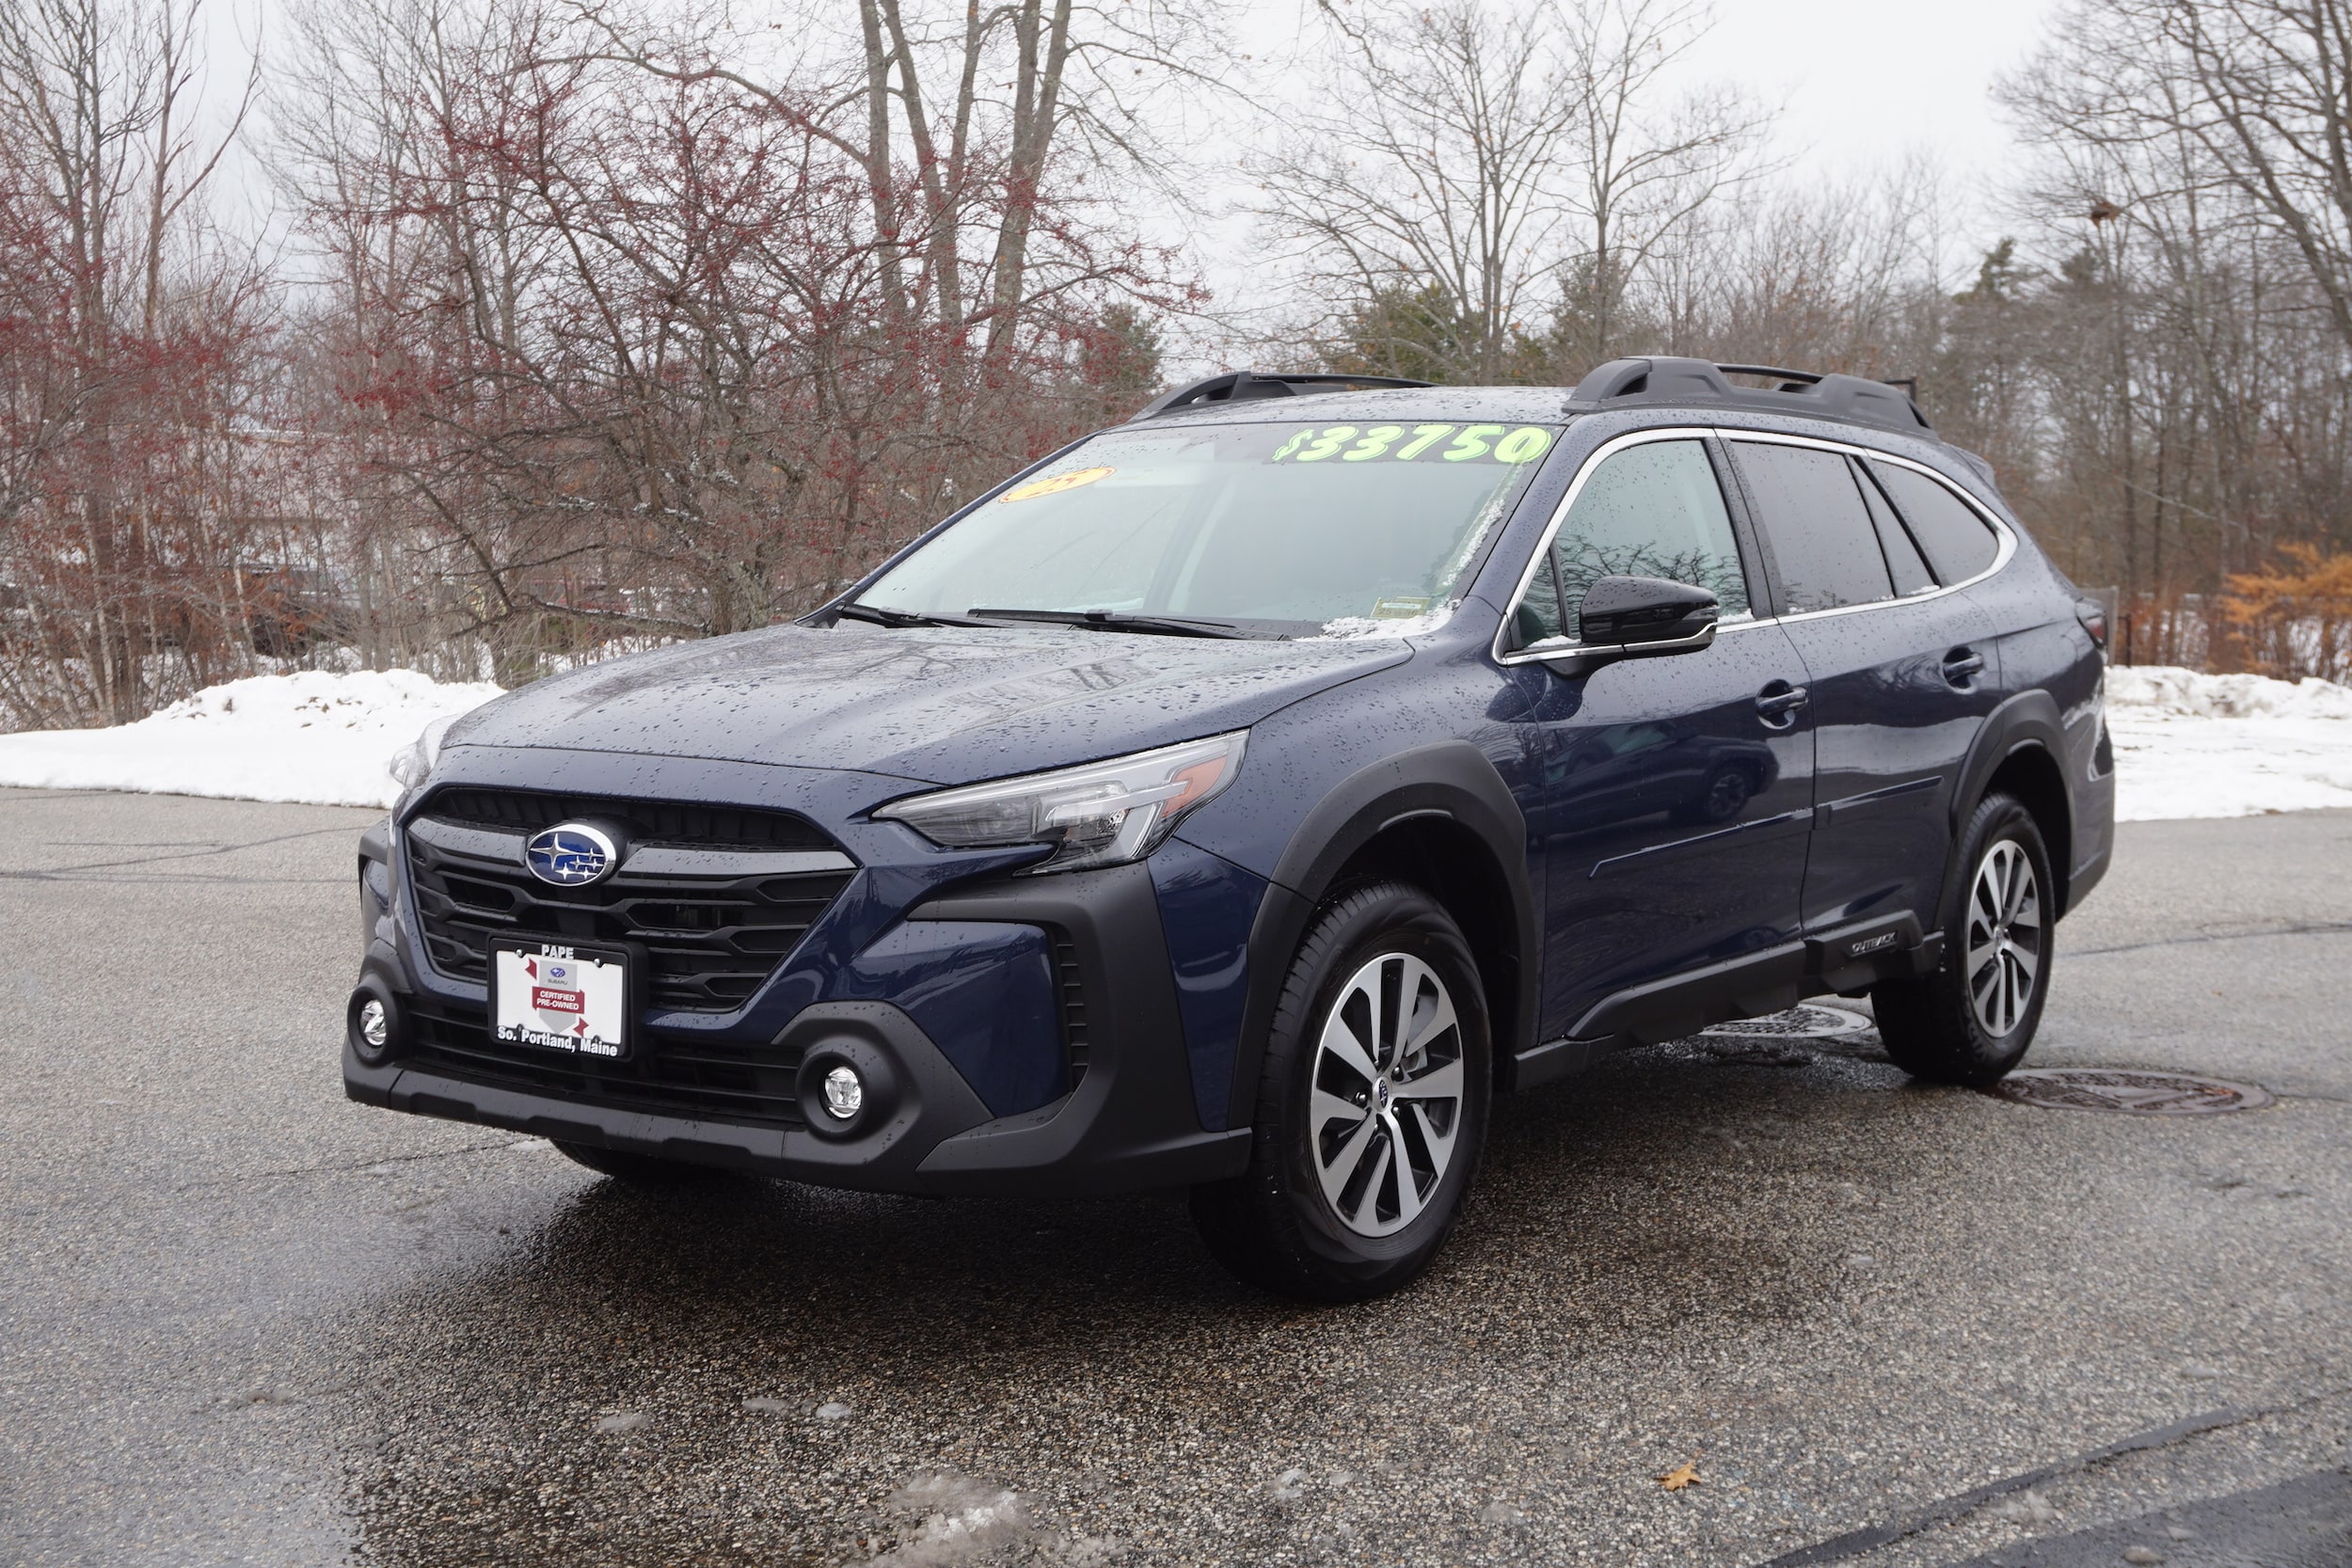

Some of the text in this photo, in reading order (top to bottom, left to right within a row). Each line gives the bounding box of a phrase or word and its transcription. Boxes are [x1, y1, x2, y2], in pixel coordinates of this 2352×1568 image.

[1272, 425, 1551, 464] $33750
[541, 943, 575, 959] PAPE
[1851, 931, 1896, 953] OUTBACK
[536, 998, 580, 1010] PRE-OWNED
[539, 990, 576, 1002] CERTIFIED
[497, 1025, 618, 1057] So. Portland, Maine
